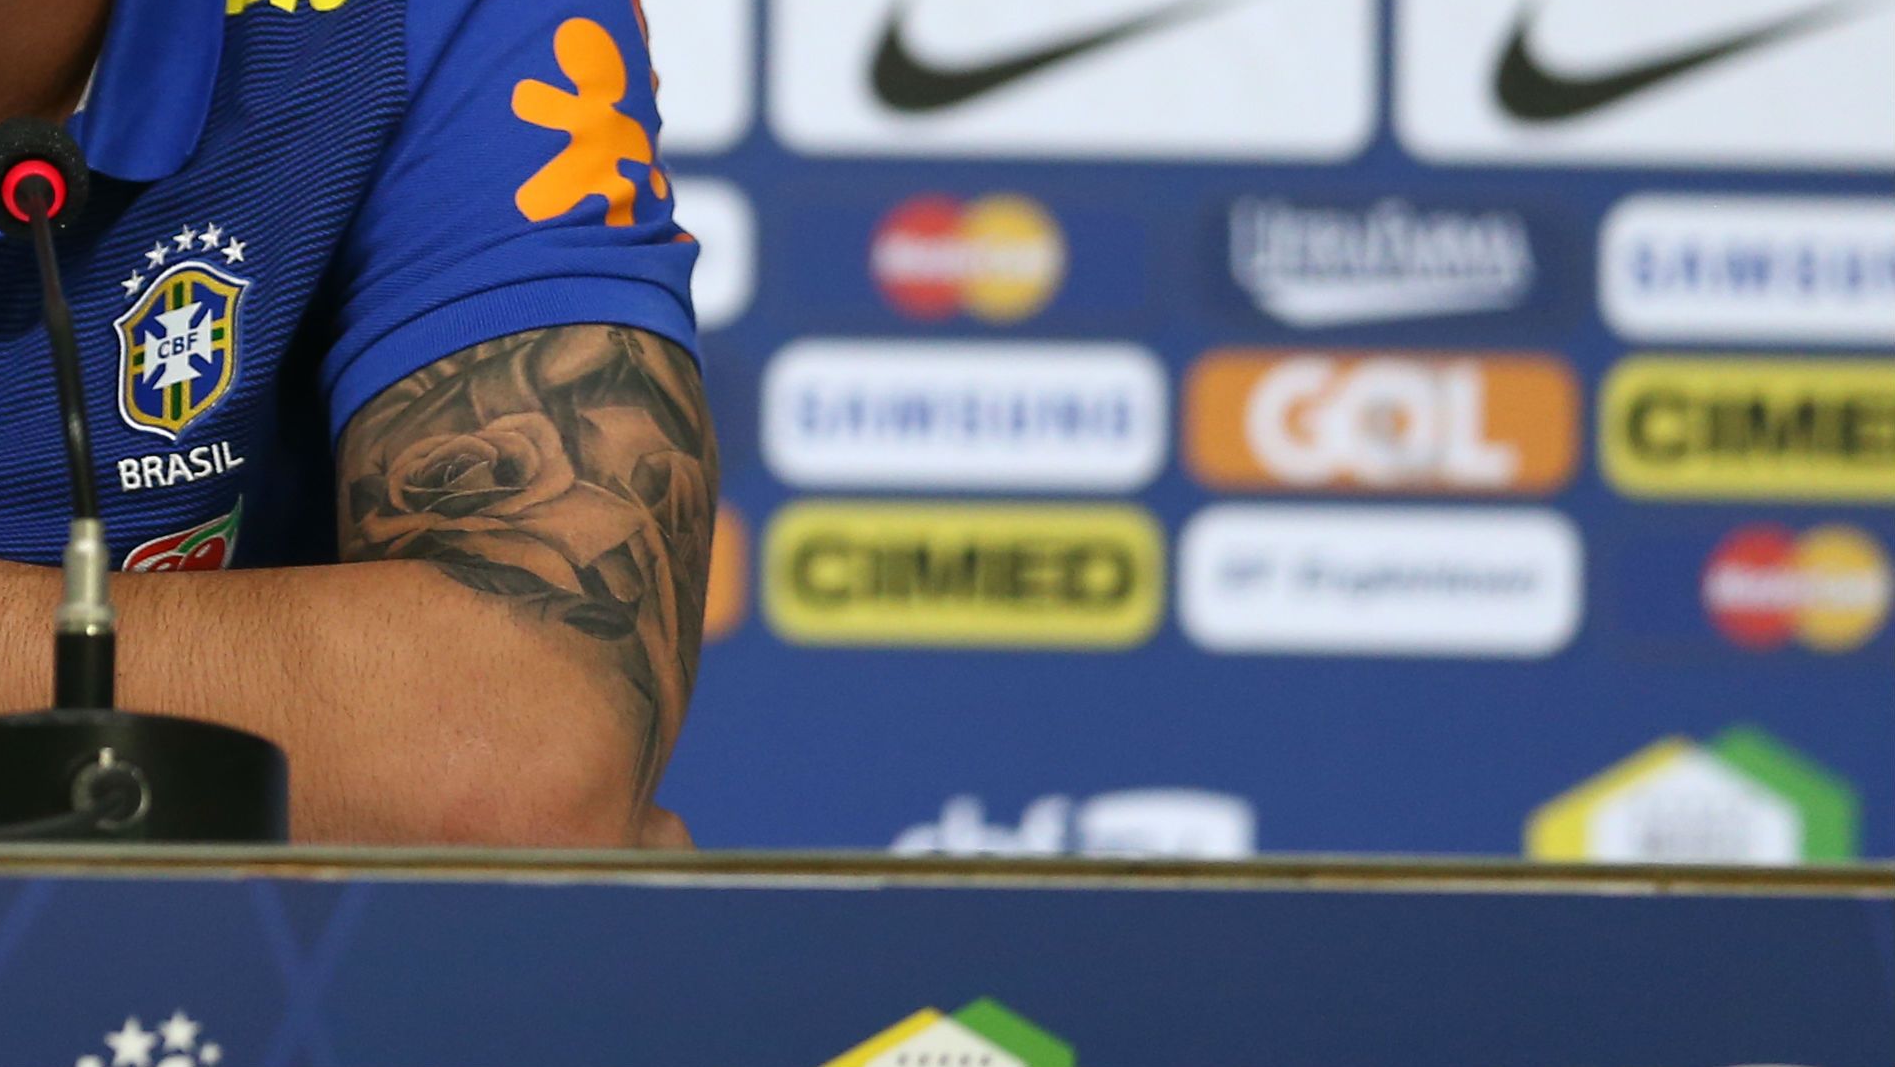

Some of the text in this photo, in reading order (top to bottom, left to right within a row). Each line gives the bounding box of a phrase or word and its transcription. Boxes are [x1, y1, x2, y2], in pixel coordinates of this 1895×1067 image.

[1627, 236, 1895, 296] SAMSU
[157, 332, 200, 359] CBF
[1244, 353, 1525, 487] GOL
[1621, 382, 1895, 466] CIME
[117, 441, 244, 492] BRASIL
[787, 528, 1141, 614] CIMED
